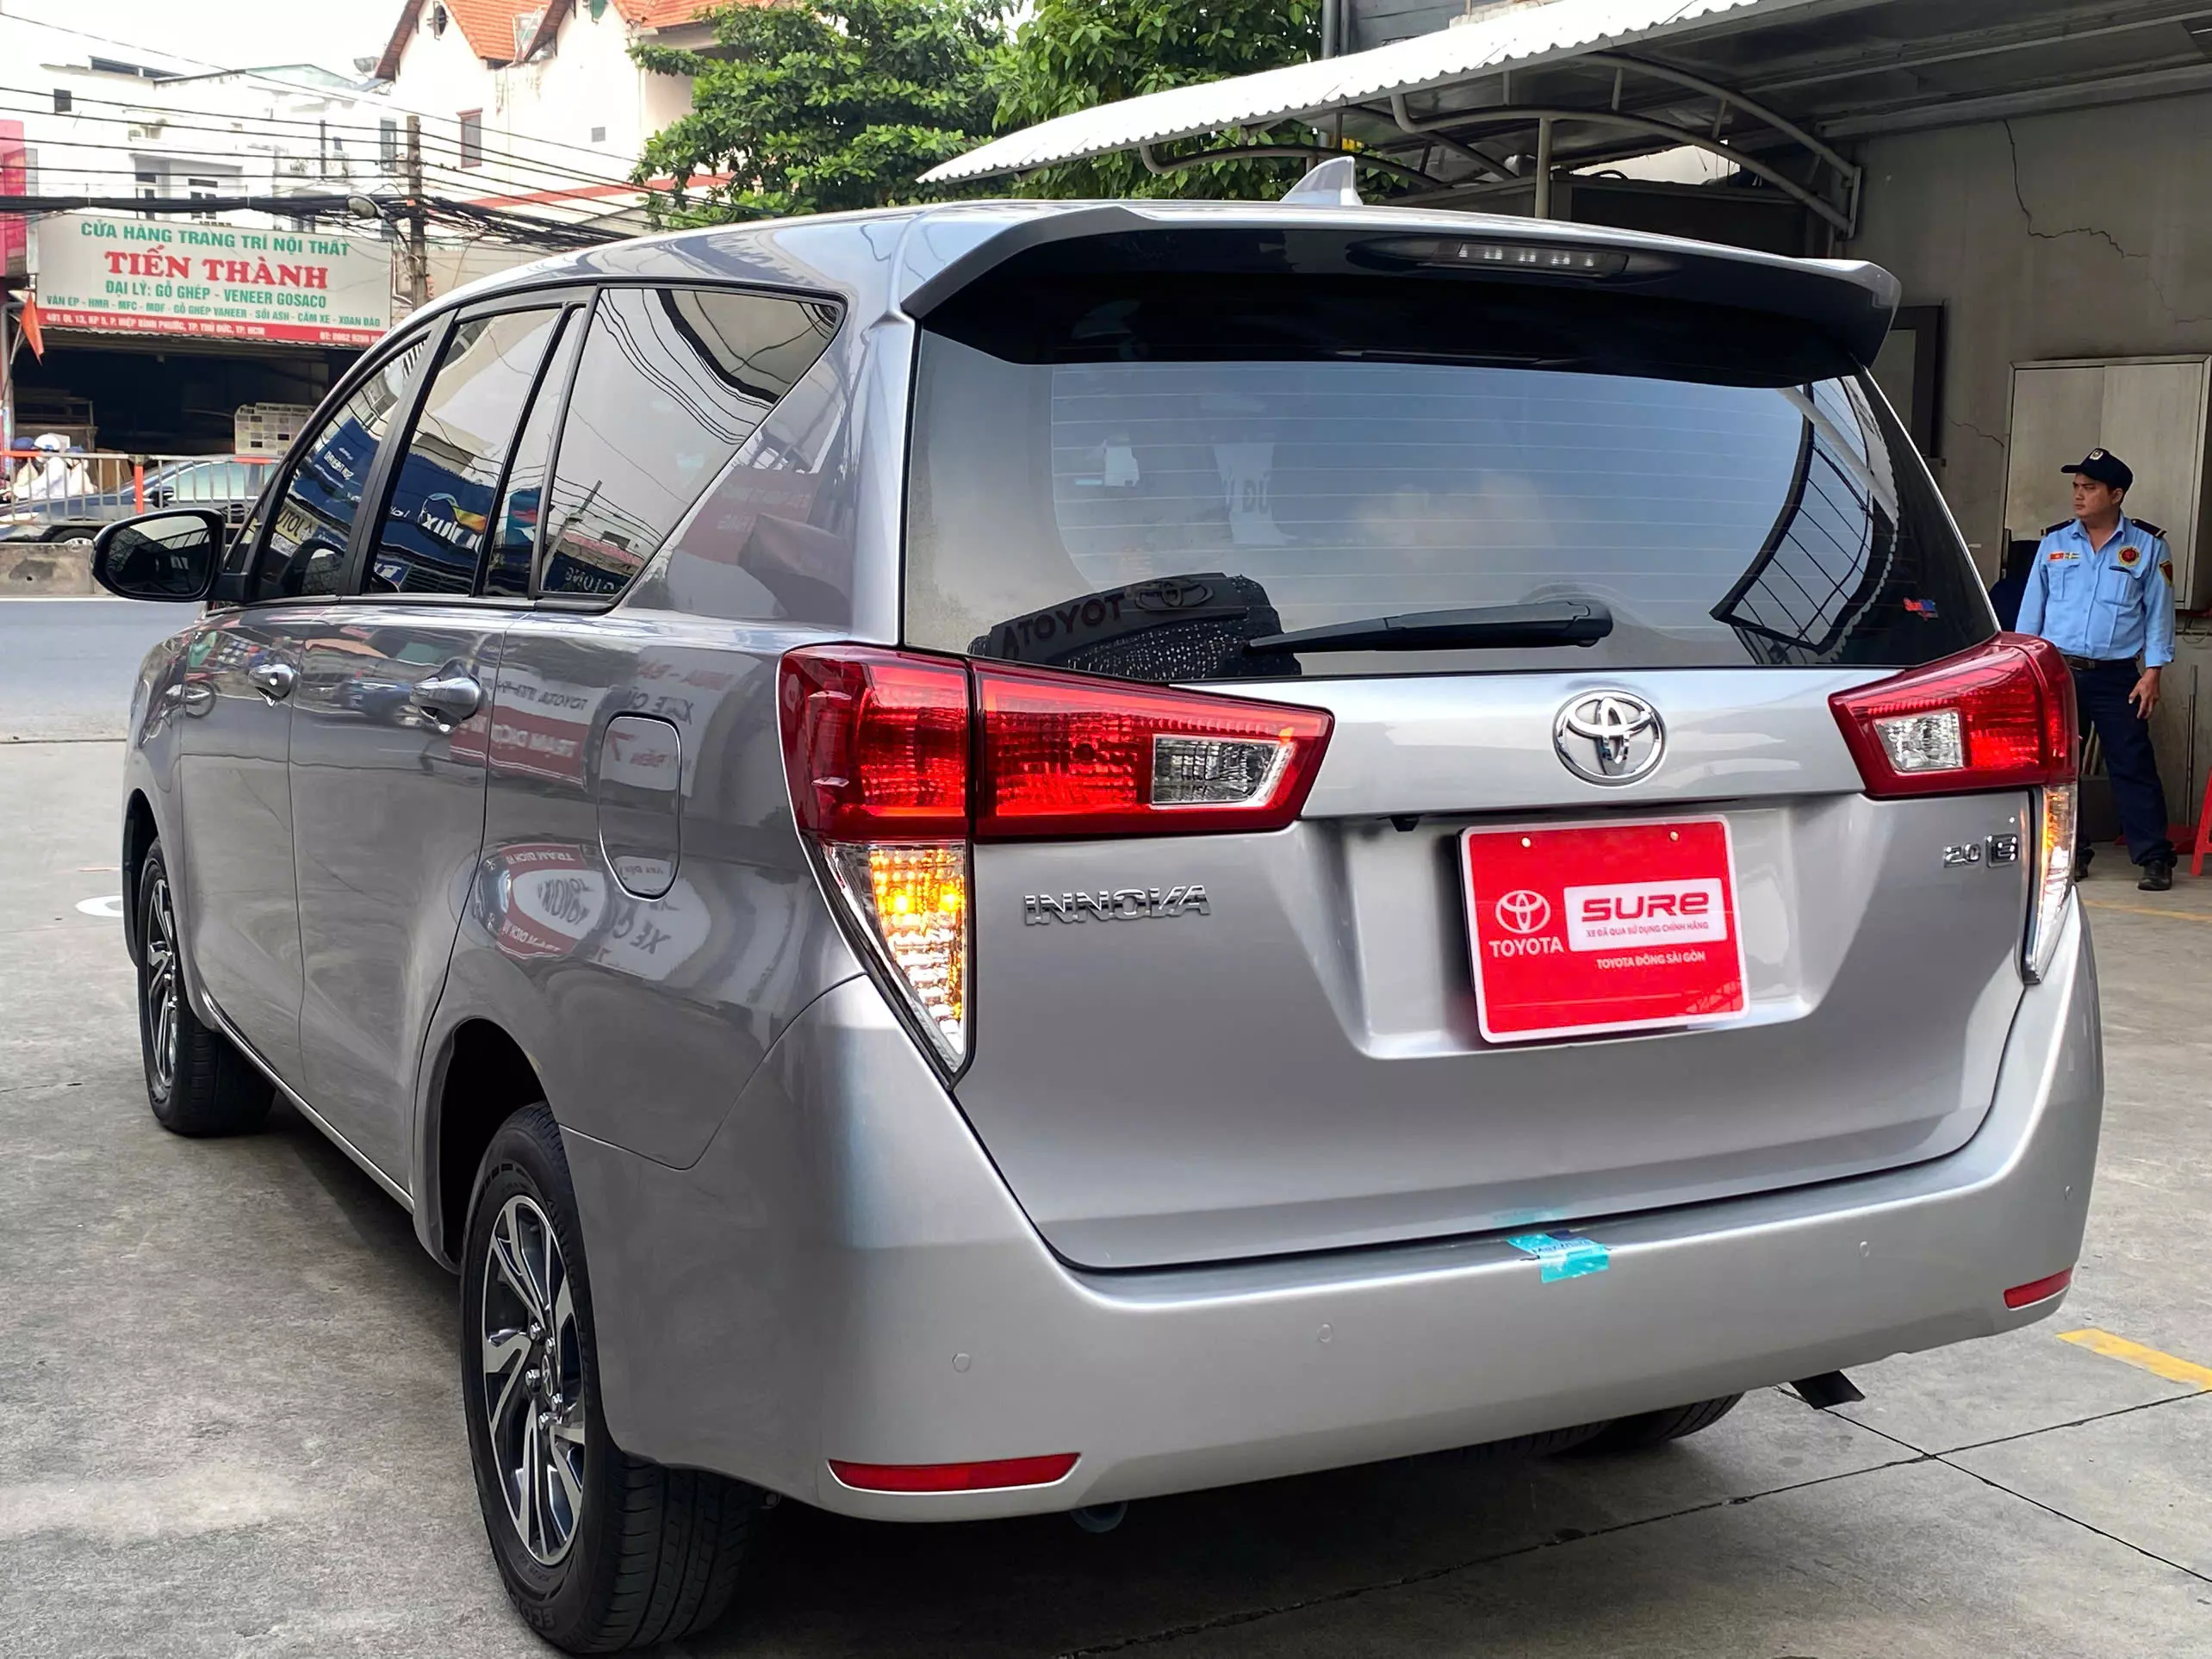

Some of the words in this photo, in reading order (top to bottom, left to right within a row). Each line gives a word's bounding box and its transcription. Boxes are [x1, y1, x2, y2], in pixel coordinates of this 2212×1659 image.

[81, 219, 117, 239] CỬA
[123, 224, 172, 242] HÀNG
[178, 229, 235, 247] TRANG
[241, 233, 268, 250] TRÍ
[273, 237, 302, 255] NỘI
[308, 238, 350, 256] THẤT
[202, 256, 328, 289] THÀNH
[106, 280, 128, 297] ĐẠI
[177, 284, 210, 300] GHÉP
[224, 289, 273, 305] VENEER
[276, 292, 326, 308] GOSACO
[88, 298, 109, 308] HMR
[118, 301, 137, 311] MFC
[146, 302, 165, 312] MDF
[272, 311, 289, 321] ASH
[320, 314, 331, 324] XE
[339, 315, 361, 326] XOAN
[1023, 884, 1210, 926] INNOVA
[1586, 929, 1596, 938] XE
[1597, 927, 1608, 937] ĐÃ
[1609, 928, 1625, 936] QUA
[1638, 924, 1662, 935] DỤNG
[1662, 922, 1686, 932] CHÍNH
[1687, 920, 1709, 930] HÃNG
[1488, 935, 1564, 958] TOYOTA
[1596, 957, 1635, 969] TOYOTA
[1635, 953, 1665, 966] ĐÔNG
[1666, 950, 1682, 964] SÀI
[1682, 948, 1706, 962] GÒN
